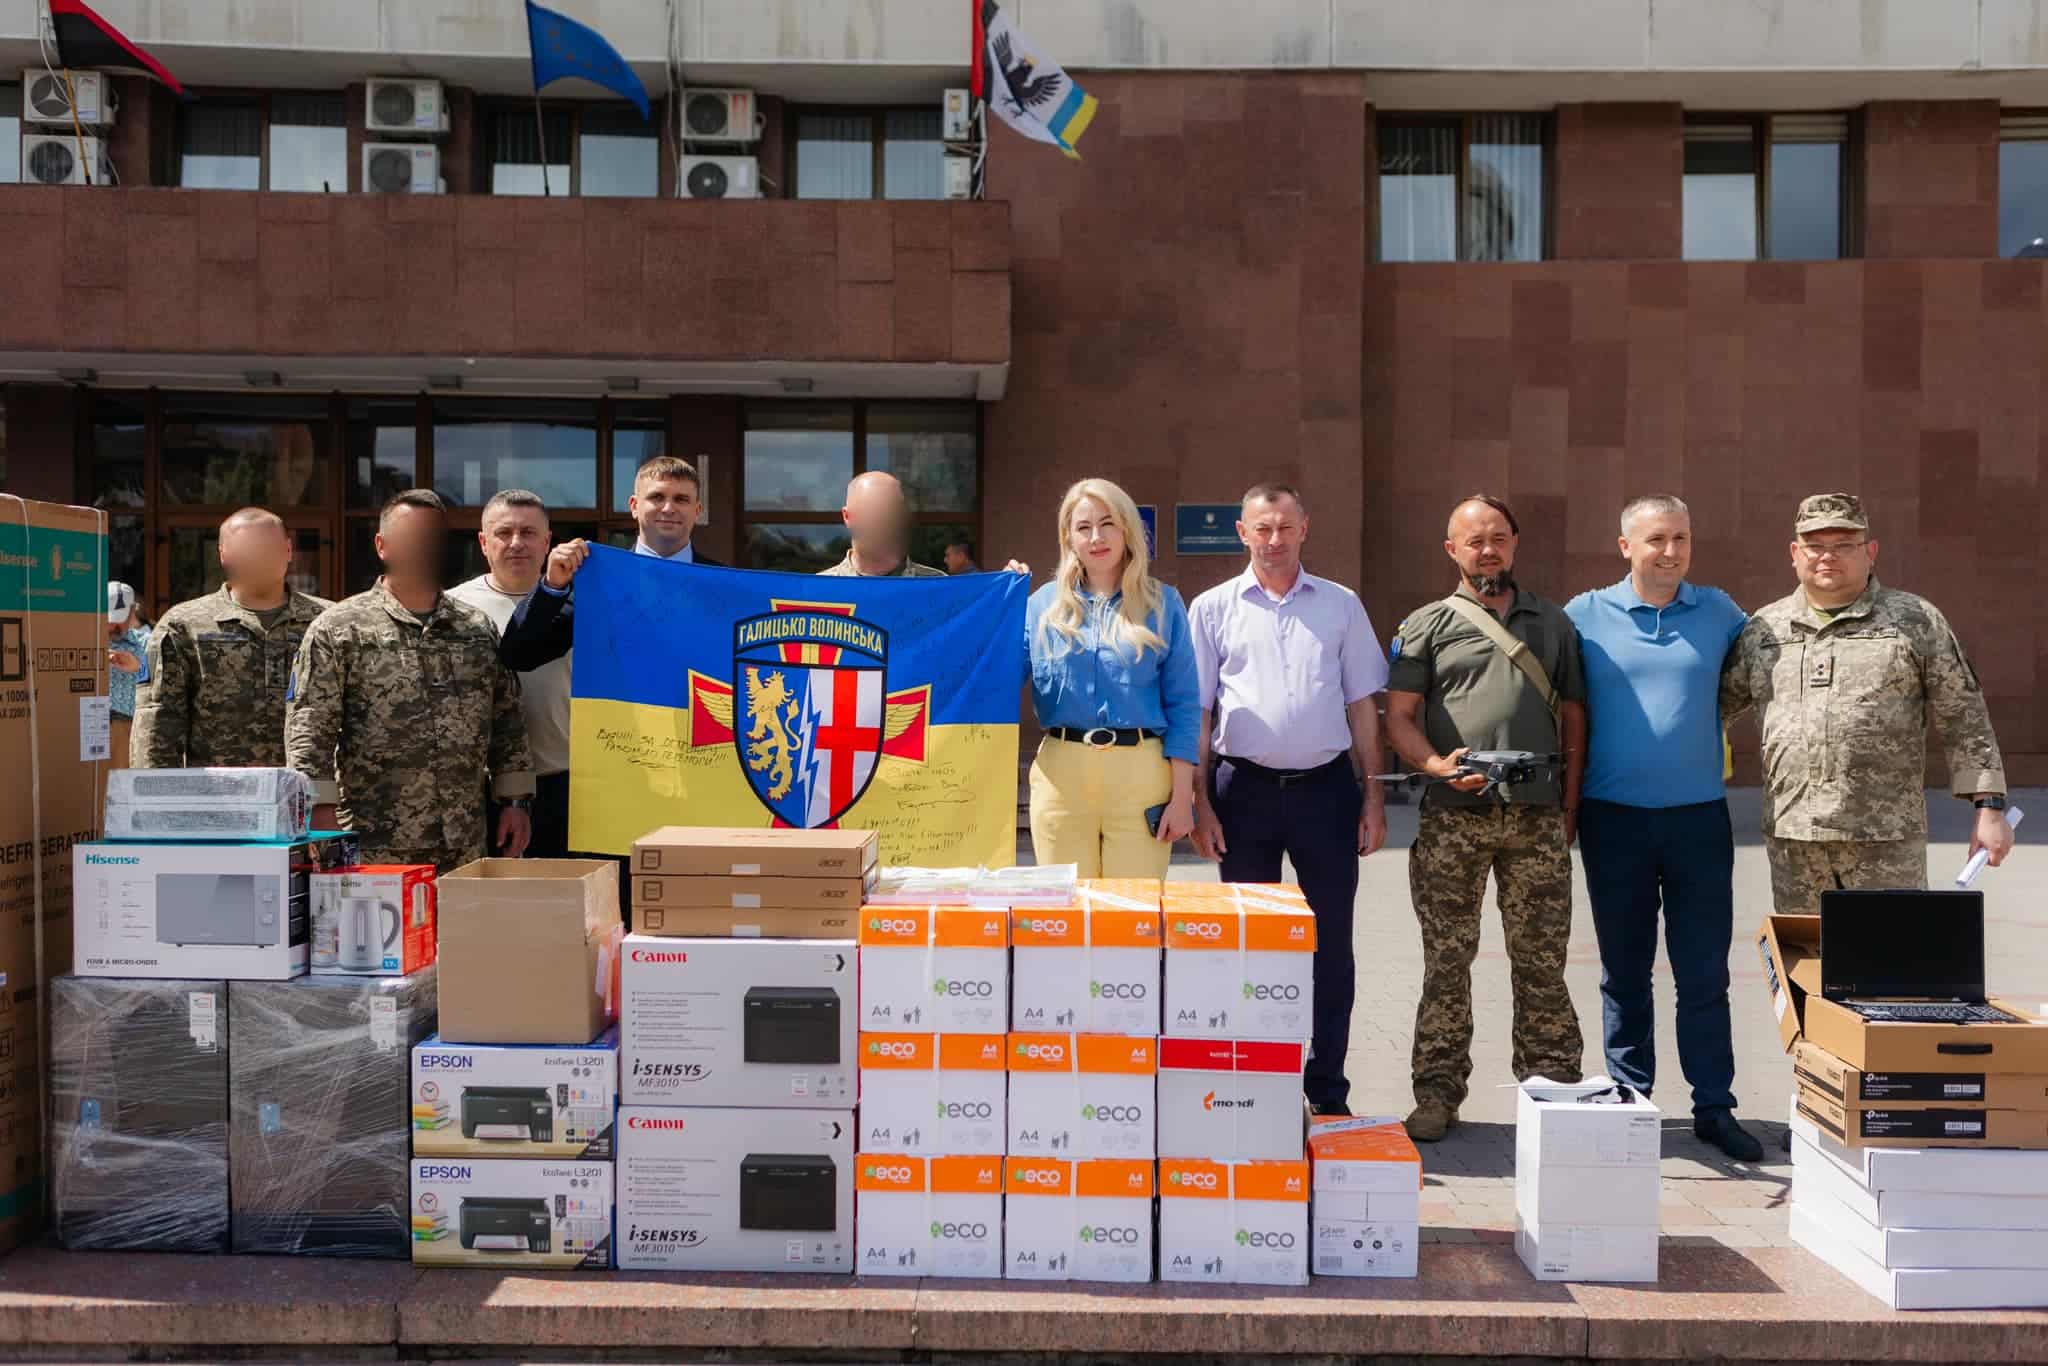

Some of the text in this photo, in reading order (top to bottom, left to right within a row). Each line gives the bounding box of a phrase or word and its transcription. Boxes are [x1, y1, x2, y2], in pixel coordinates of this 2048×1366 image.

[739, 617, 883, 654] ГАЛИЦЬКО ВОЛИНСЬКА
[85, 853, 141, 865] Hisense
[818, 857, 847, 868] acer
[820, 889, 848, 899] acer
[821, 918, 848, 928] acer
[880, 919, 917, 932] eco
[1031, 919, 1068, 932] eco
[1185, 922, 1222, 936] eco
[631, 950, 687, 963] Canon
[948, 980, 993, 996] eco
[1101, 983, 1147, 999] eco
[1254, 984, 1300, 1000] eco
[872, 1005, 891, 1016] A4
[1024, 1007, 1044, 1018] A4
[1177, 1009, 1197, 1020] A4
[880, 1042, 916, 1056] eco
[1027, 1044, 1064, 1058] eco
[421, 1055, 473, 1068] EPSON
[633, 1058, 702, 1076] i-SENSYS
[638, 1077, 680, 1088] MF3010
[947, 1102, 992, 1118] eco
[1096, 1106, 1142, 1122] eco
[628, 1117, 684, 1130] Canon
[871, 1128, 891, 1139] A4
[1019, 1130, 1039, 1141] A4
[419, 1166, 472, 1179] EPSON
[876, 1166, 912, 1180] eco
[1024, 1169, 1061, 1183] eco
[1181, 1172, 1217, 1187] eco
[629, 1224, 698, 1242] i-SENSYS
[943, 1222, 987, 1239] eco
[1093, 1227, 1138, 1243] eco
[1250, 1232, 1295, 1248] eco
[634, 1244, 676, 1254] MF3010
[867, 1247, 886, 1258] A4
[1017, 1251, 1036, 1262] A4
[1172, 1255, 1192, 1265] A4
